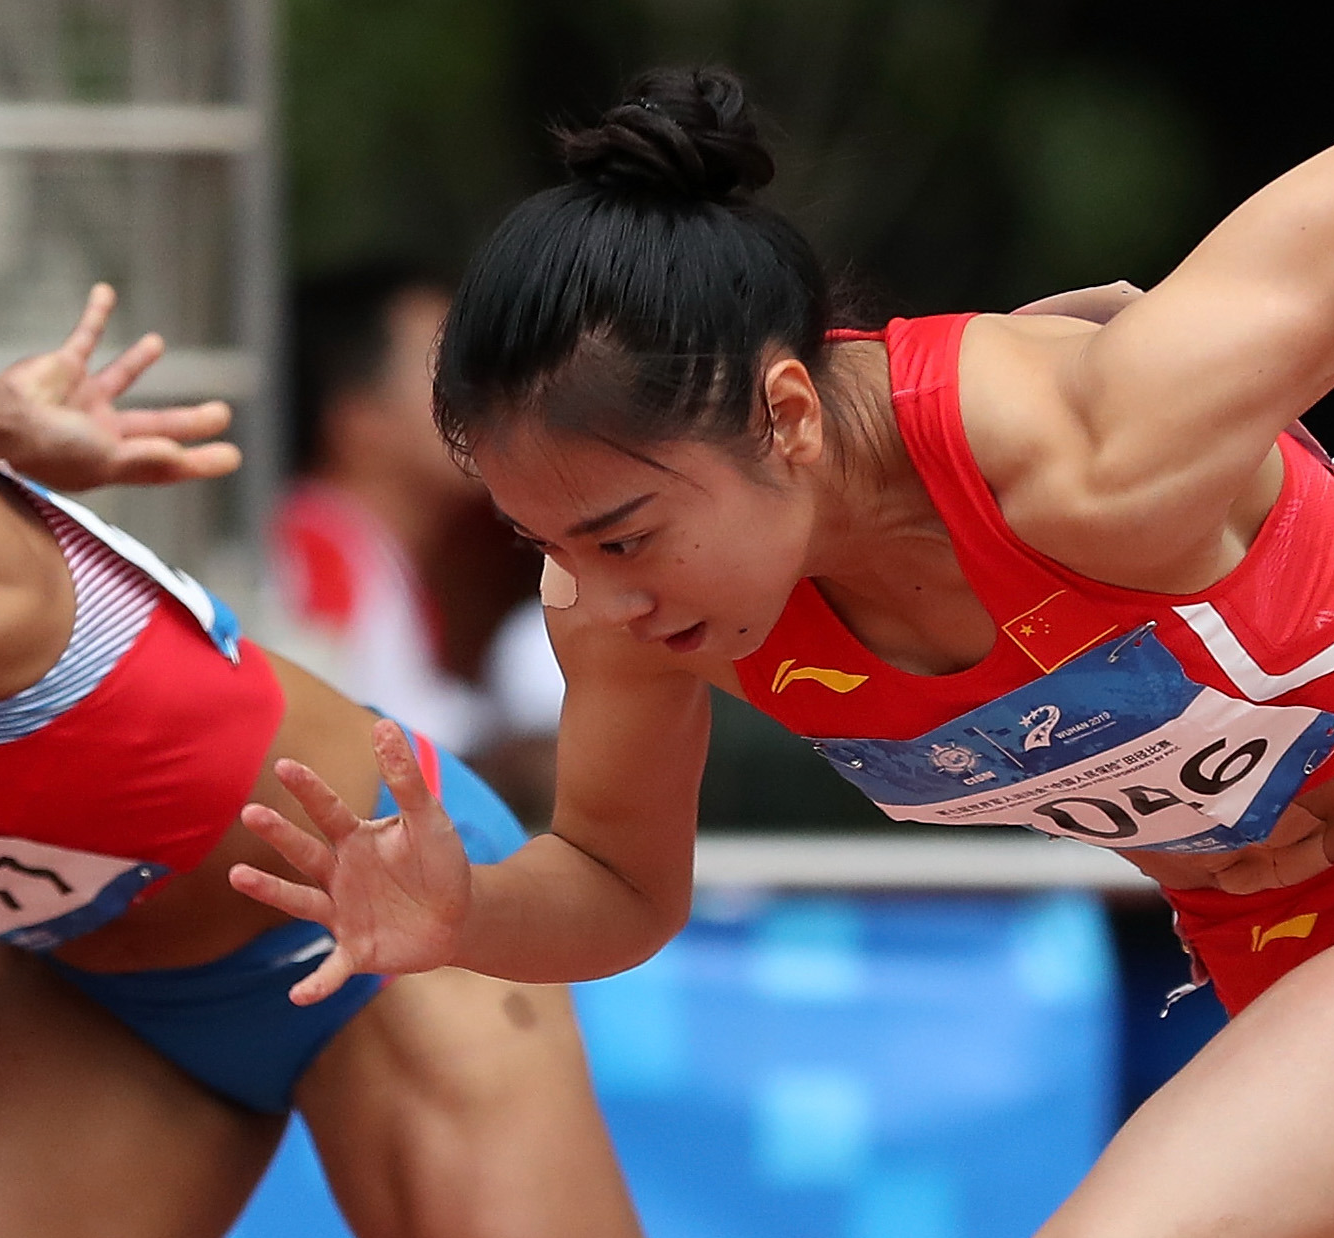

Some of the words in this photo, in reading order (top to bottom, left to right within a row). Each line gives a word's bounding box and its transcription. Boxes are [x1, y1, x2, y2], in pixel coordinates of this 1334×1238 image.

[1055, 721, 1090, 739] WUHAN
[1087, 711, 1112, 726] 2019
[1033, 737, 1270, 839] 046
